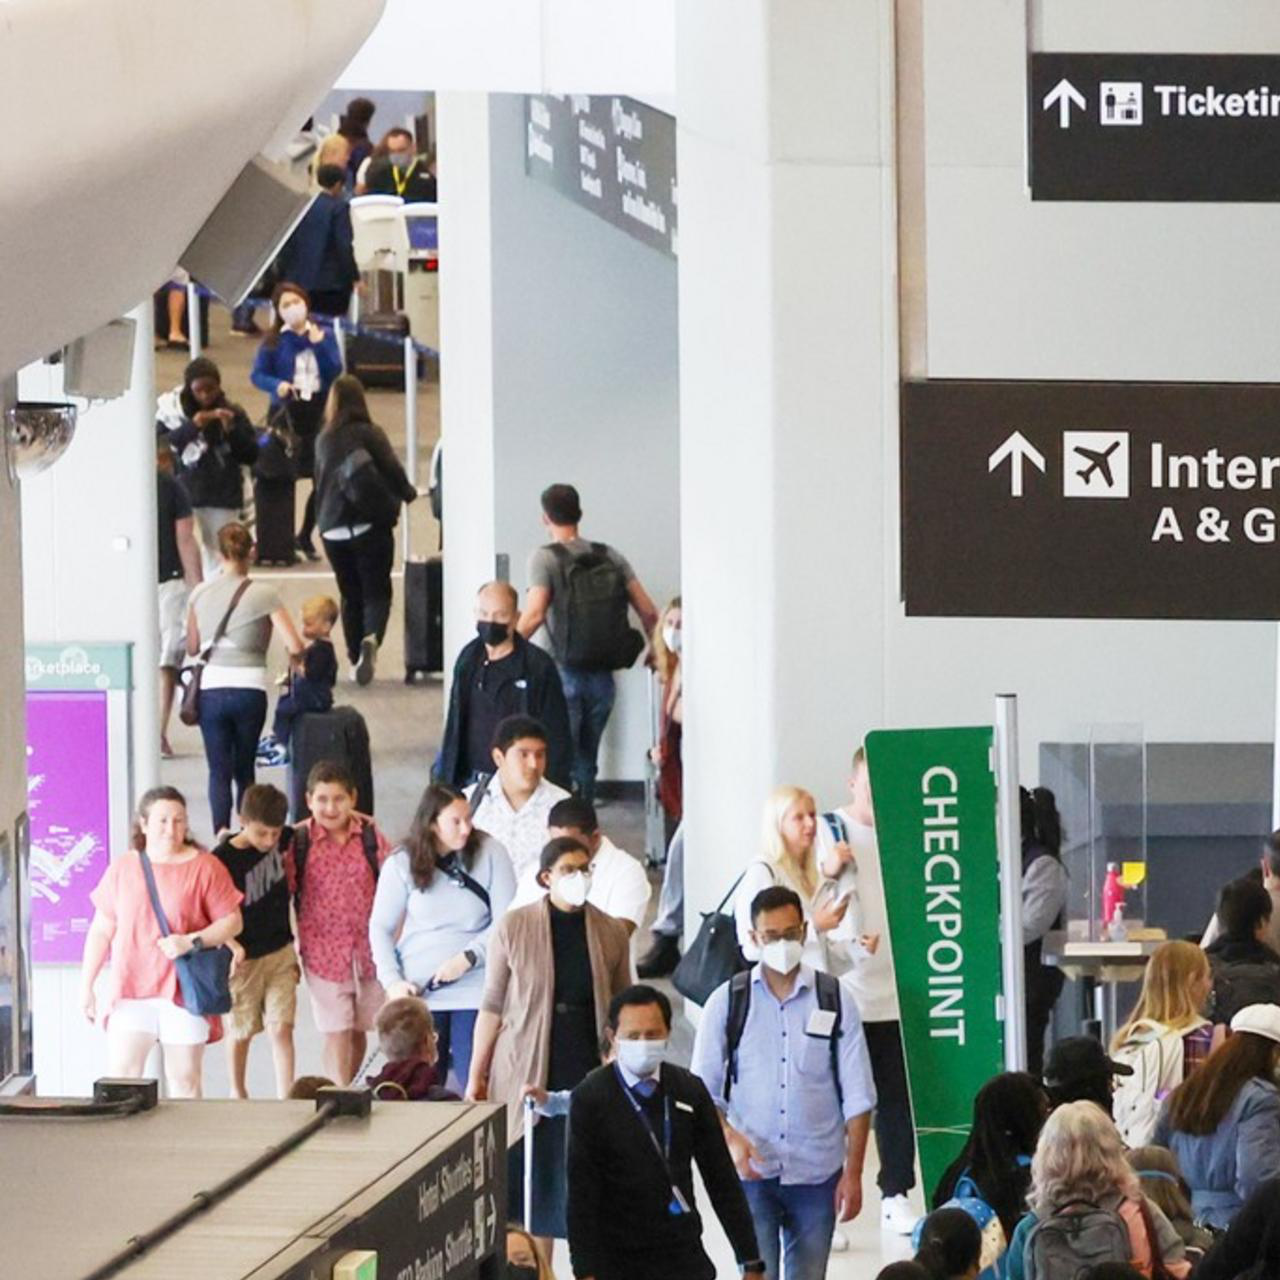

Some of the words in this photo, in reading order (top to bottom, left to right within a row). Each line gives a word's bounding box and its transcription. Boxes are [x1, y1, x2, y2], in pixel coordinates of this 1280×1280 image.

[1152, 507, 1184, 542] A
[1196, 507, 1231, 543] &
[1244, 508, 1276, 543] G
[25, 661, 101, 676] arketplace
[921, 766, 965, 1045] CHECKPOINT
[418, 1177, 439, 1221] Hotel
[441, 1152, 473, 1204] Shuttles
[444, 1221, 473, 1273] Shuttle
